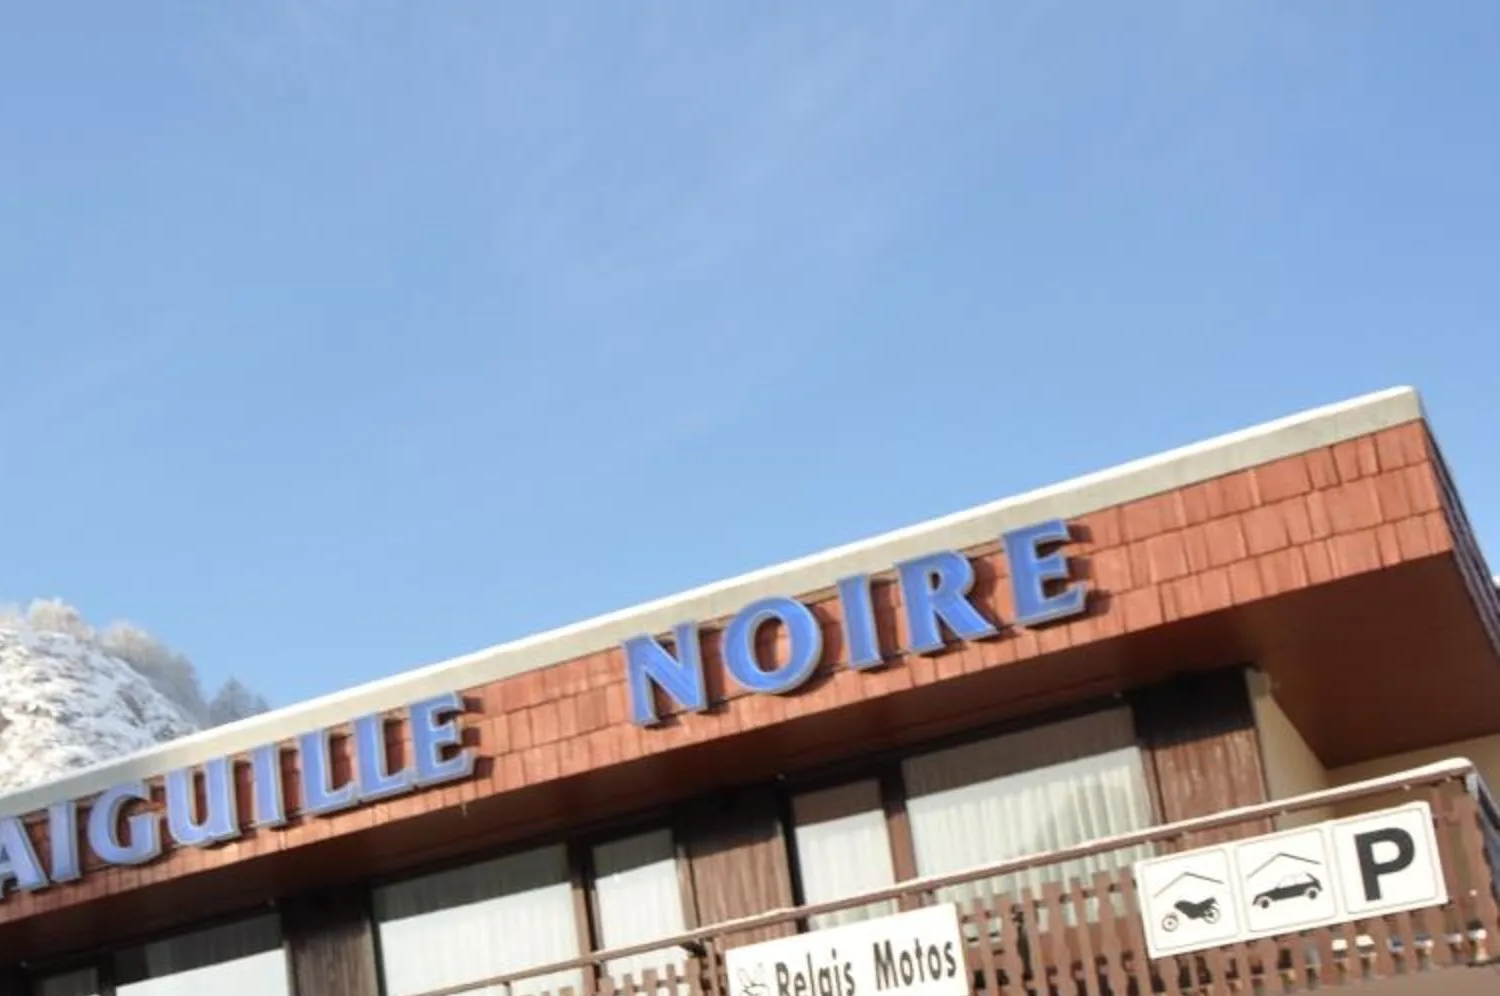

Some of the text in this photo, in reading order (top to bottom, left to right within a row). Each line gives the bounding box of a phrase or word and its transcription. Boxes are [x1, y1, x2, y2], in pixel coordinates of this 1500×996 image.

[621, 518, 1089, 729] NOIRE
[1353, 826, 1416, 901] P
[872, 937, 958, 992] Motos
